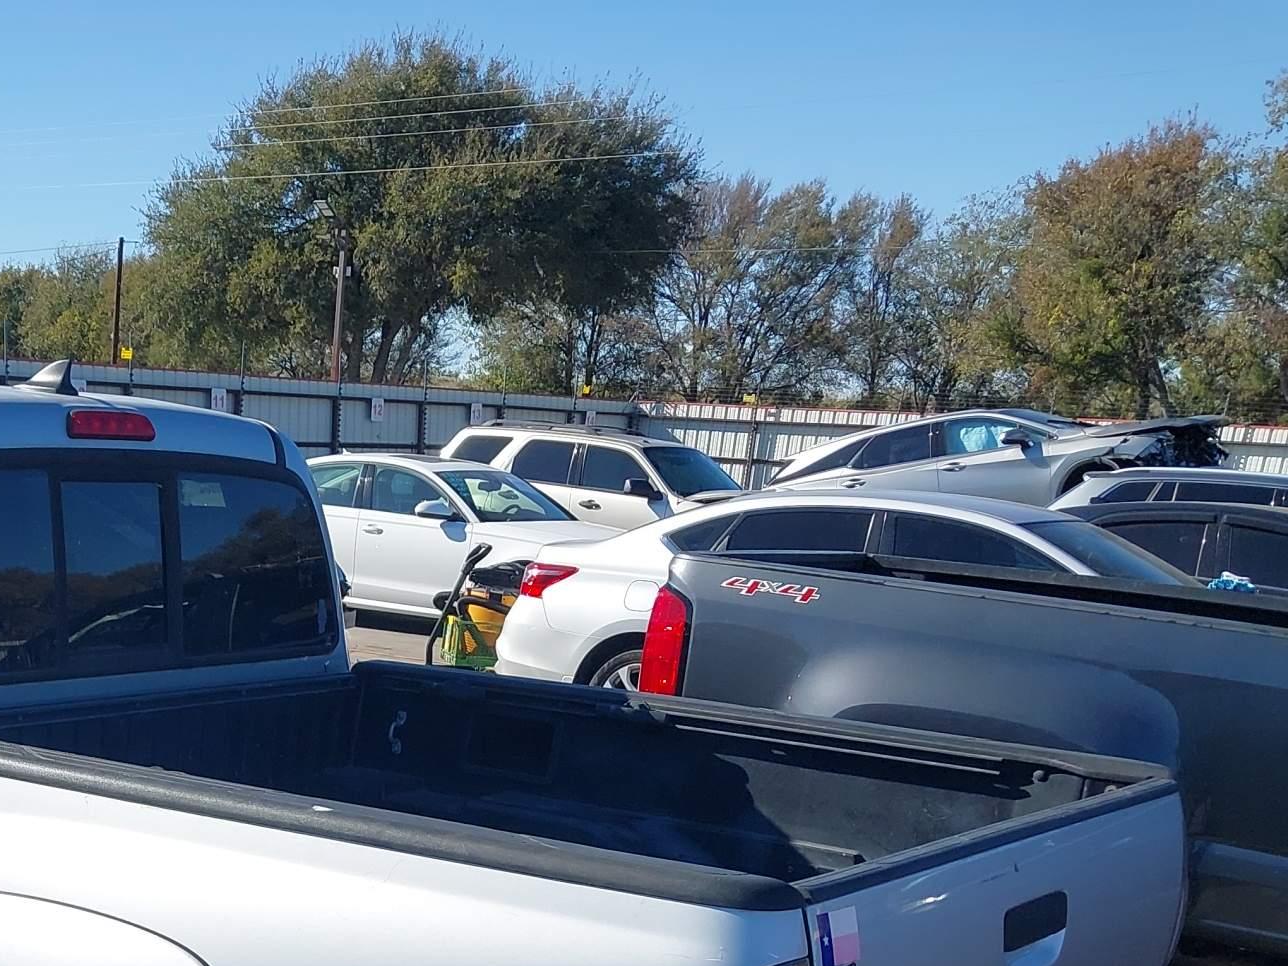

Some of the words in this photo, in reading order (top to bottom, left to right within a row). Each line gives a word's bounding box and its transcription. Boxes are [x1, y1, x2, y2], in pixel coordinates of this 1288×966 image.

[213, 394, 225, 409] 11
[373, 404, 383, 417] 12
[472, 409, 481, 420] 13
